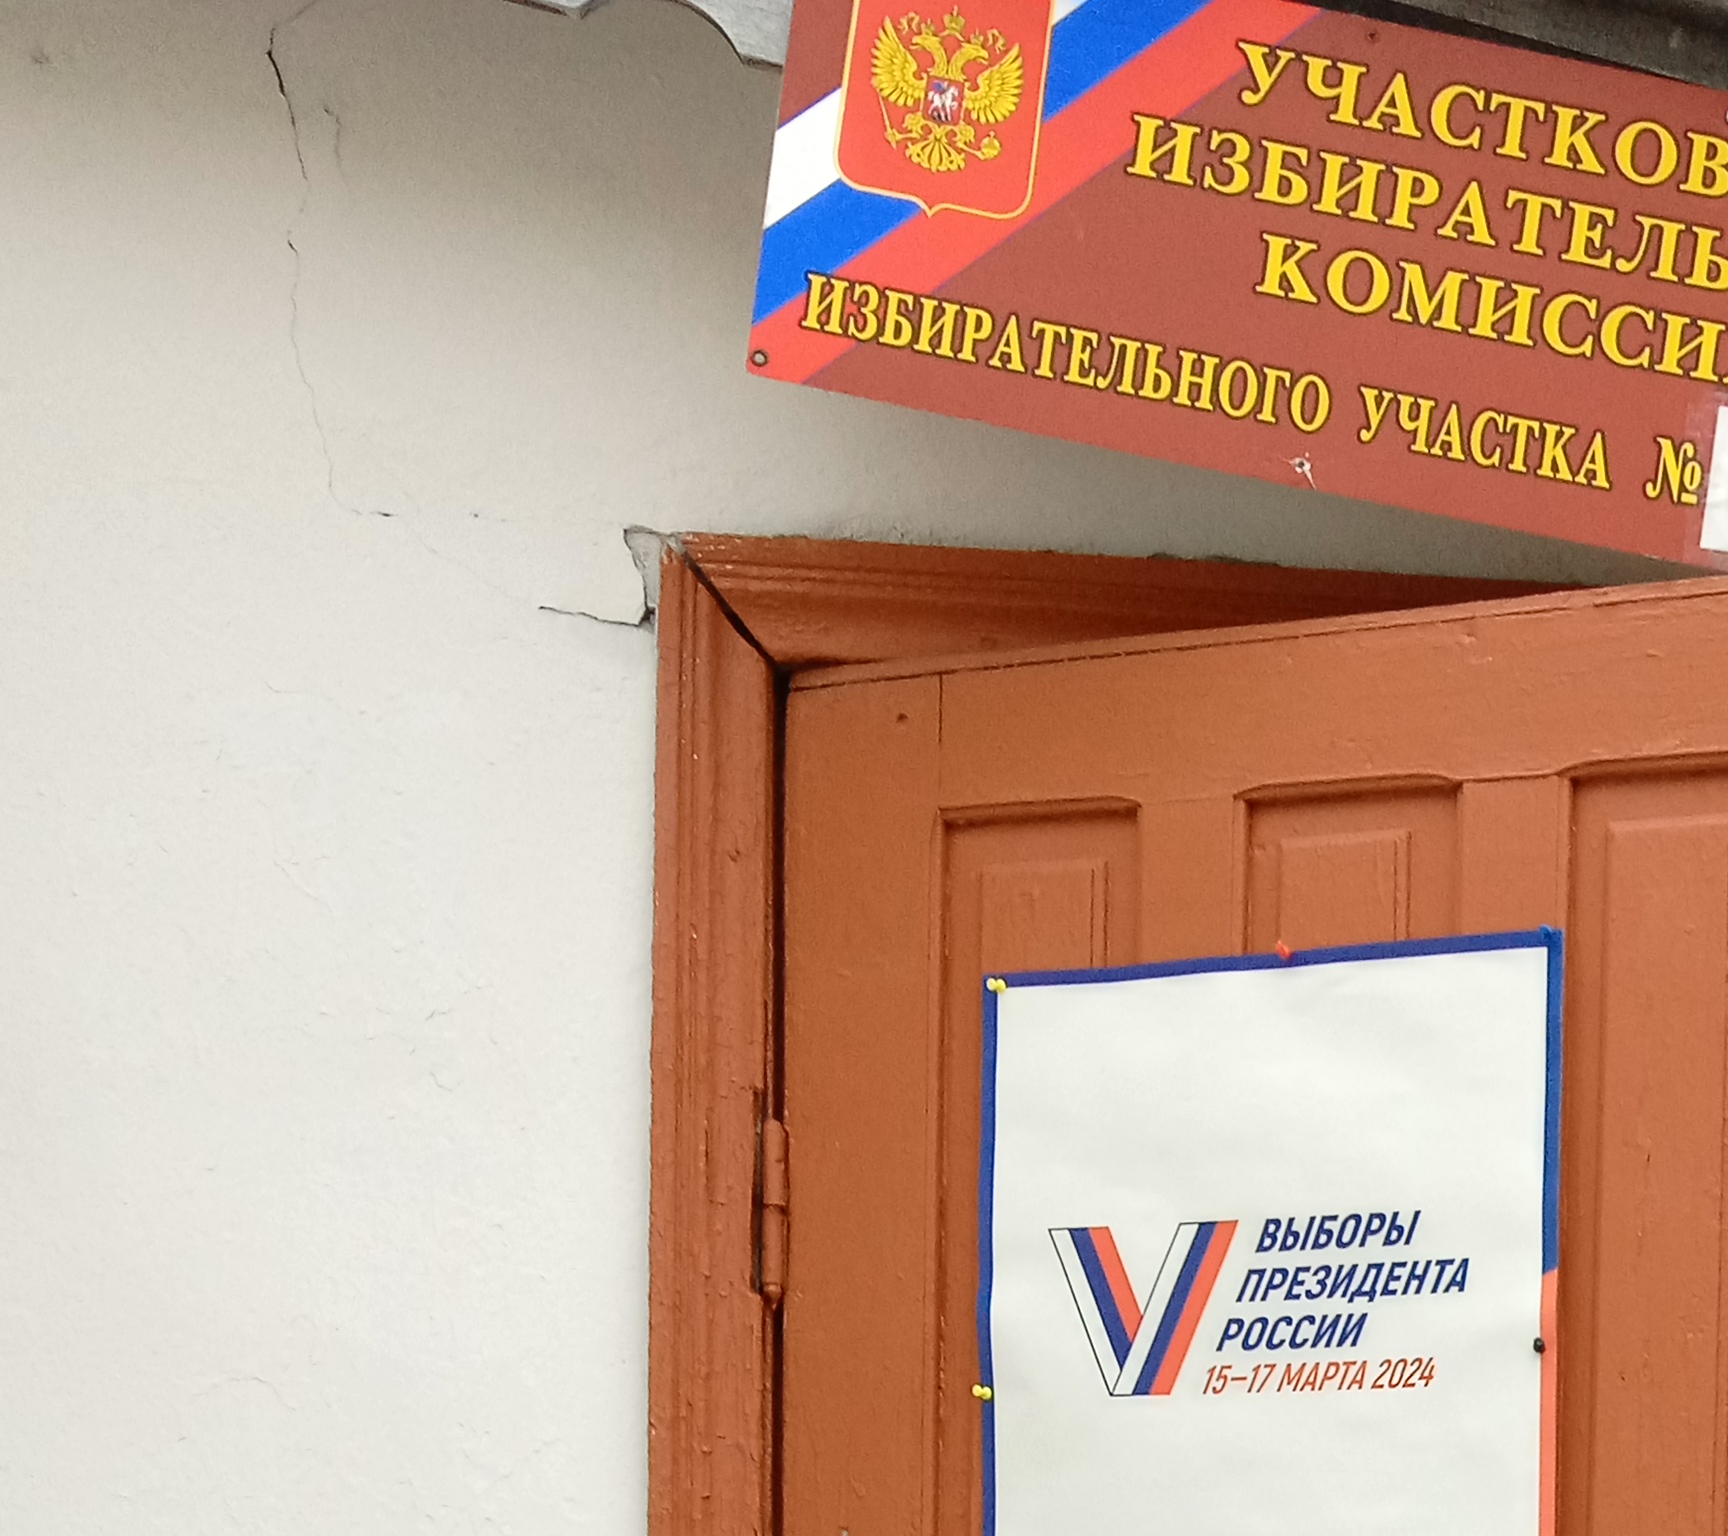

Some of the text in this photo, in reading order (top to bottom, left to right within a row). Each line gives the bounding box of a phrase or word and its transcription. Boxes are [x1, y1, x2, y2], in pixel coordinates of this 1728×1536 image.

[800, 273, 1332, 434] ИЗБИРАТЕЛЬНОГО
[1358, 385, 1611, 490] УЧАСТКА
[1645, 436, 1701, 507] №
[1255, 1211, 1421, 1253] ВЫБОРЫ
[1236, 1258, 1470, 1303] ПРЕЗИДЕНТА
[1216, 1313, 1368, 1352] РОССИИ
[1277, 1360, 1369, 1394] МАРТА
[1372, 1357, 1436, 1391] 2024
